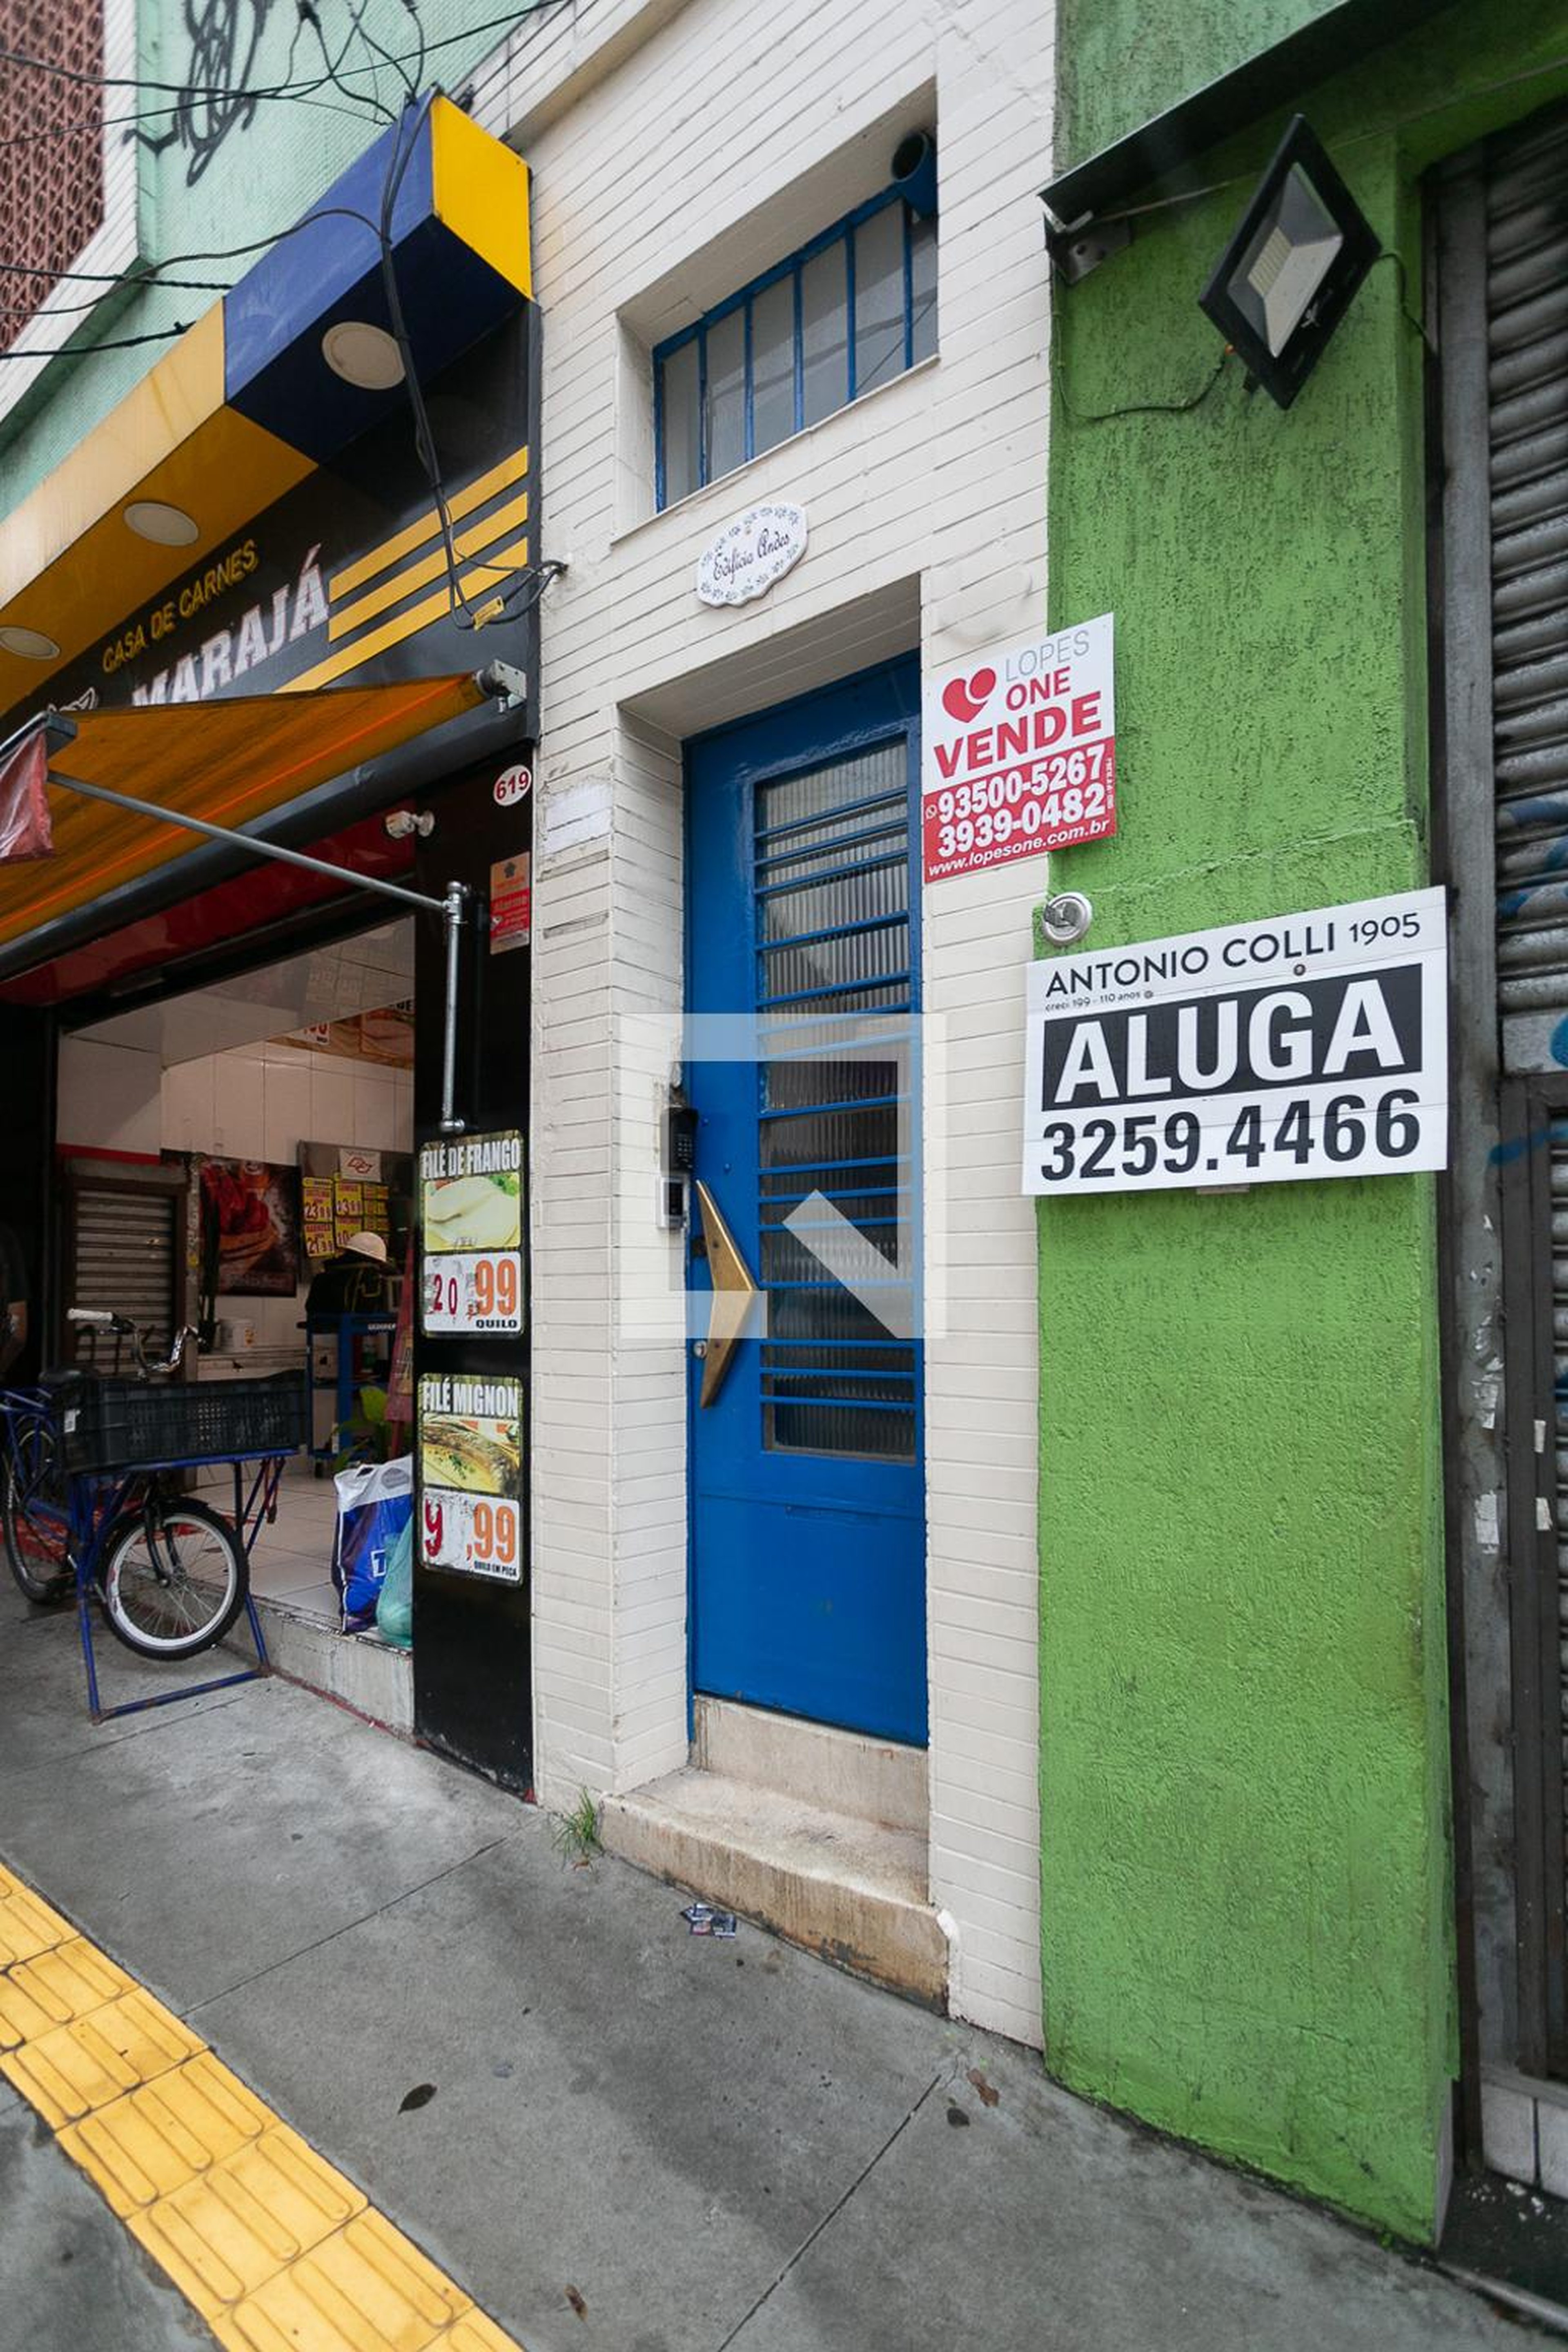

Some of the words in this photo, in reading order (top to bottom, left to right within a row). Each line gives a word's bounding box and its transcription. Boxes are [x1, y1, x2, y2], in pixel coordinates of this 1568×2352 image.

[103, 625, 147, 673] CASA
[151, 601, 176, 640] DE
[179, 539, 259, 617] CARNES
[1005, 630, 1090, 682] LOPES
[1005, 666, 1071, 711] ONE
[933, 690, 1102, 779] VENDE
[496, 771, 529, 800] 619
[938, 744, 1105, 824] 93500-5267
[929, 818, 1110, 877] www.lopesone.com.br
[938, 782, 1105, 858] 3939-0482
[1045, 947, 1209, 998] ANTONIO
[1223, 922, 1335, 968] COLLI
[1348, 912, 1421, 947] 1905
[1118, 991, 1140, 1001] anos
[1054, 979, 1405, 1104] ALUGA
[449, 1146, 464, 1176] DE
[466, 1138, 520, 1174] FRANGO
[1041, 1089, 1421, 1181] 3259.4466
[476, 1319, 517, 1329] QUILO
[423, 1377, 451, 1412] FILÉ
[453, 1383, 519, 1417] MIGNON
